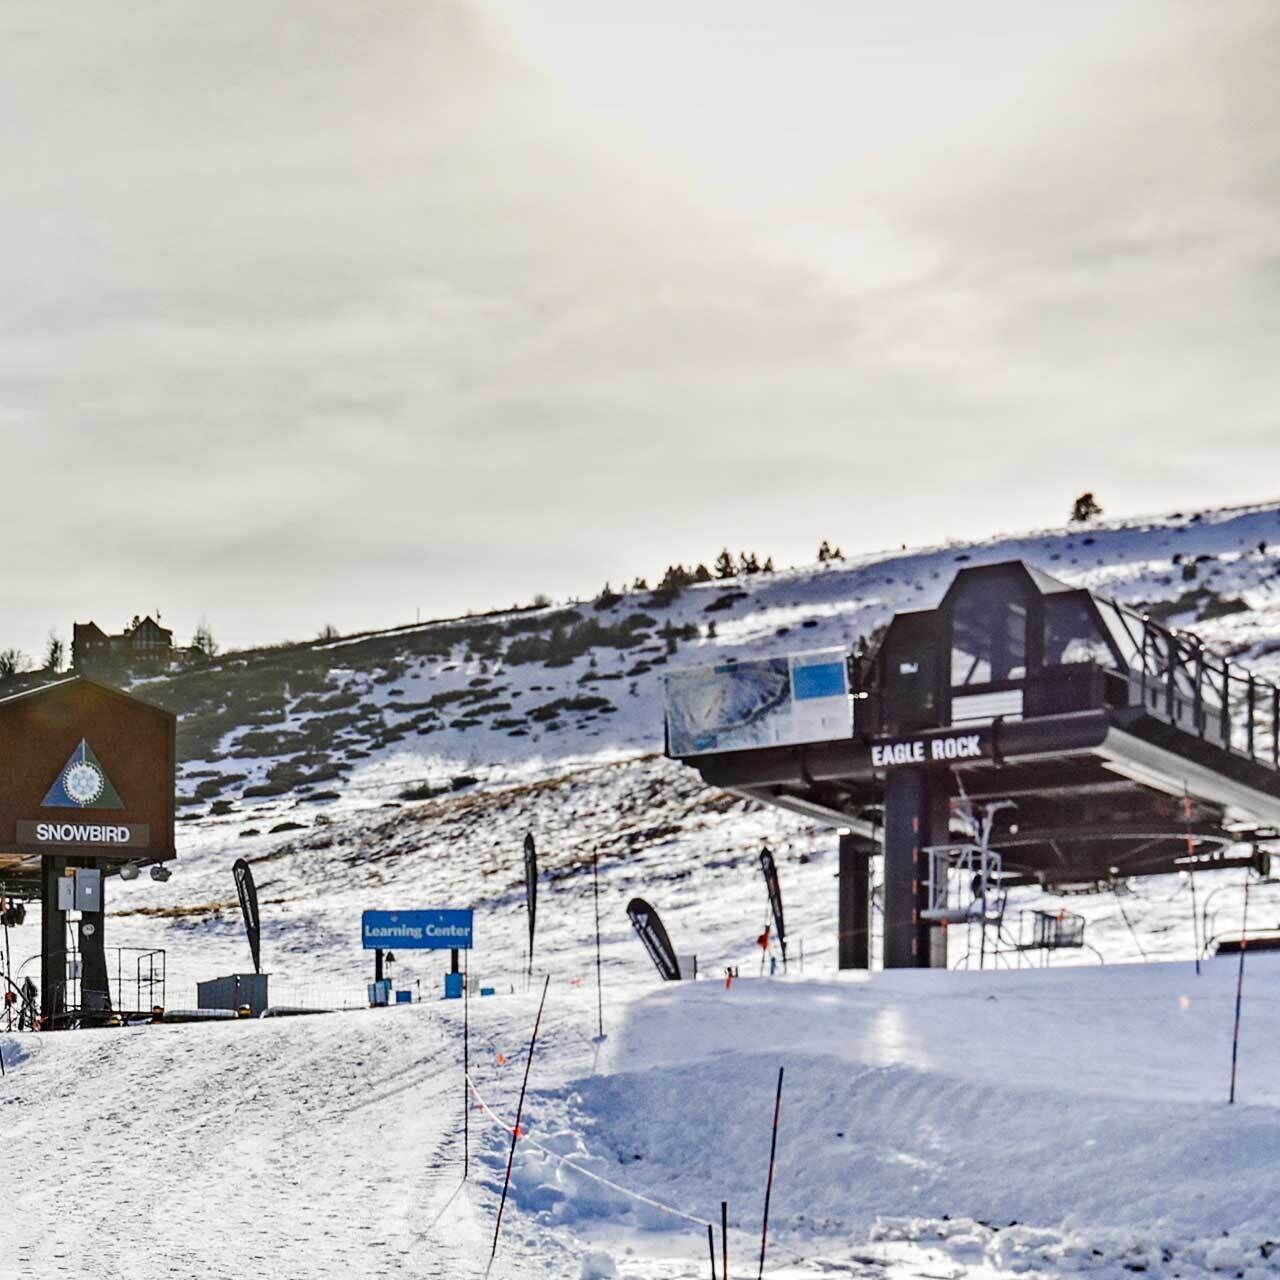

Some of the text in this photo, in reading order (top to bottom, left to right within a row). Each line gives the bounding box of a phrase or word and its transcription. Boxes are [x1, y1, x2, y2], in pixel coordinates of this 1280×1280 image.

[871, 735, 981, 767] EAGLE ROCK
[36, 824, 130, 842] SNOWBIRD
[365, 924, 471, 939] Learning Center
